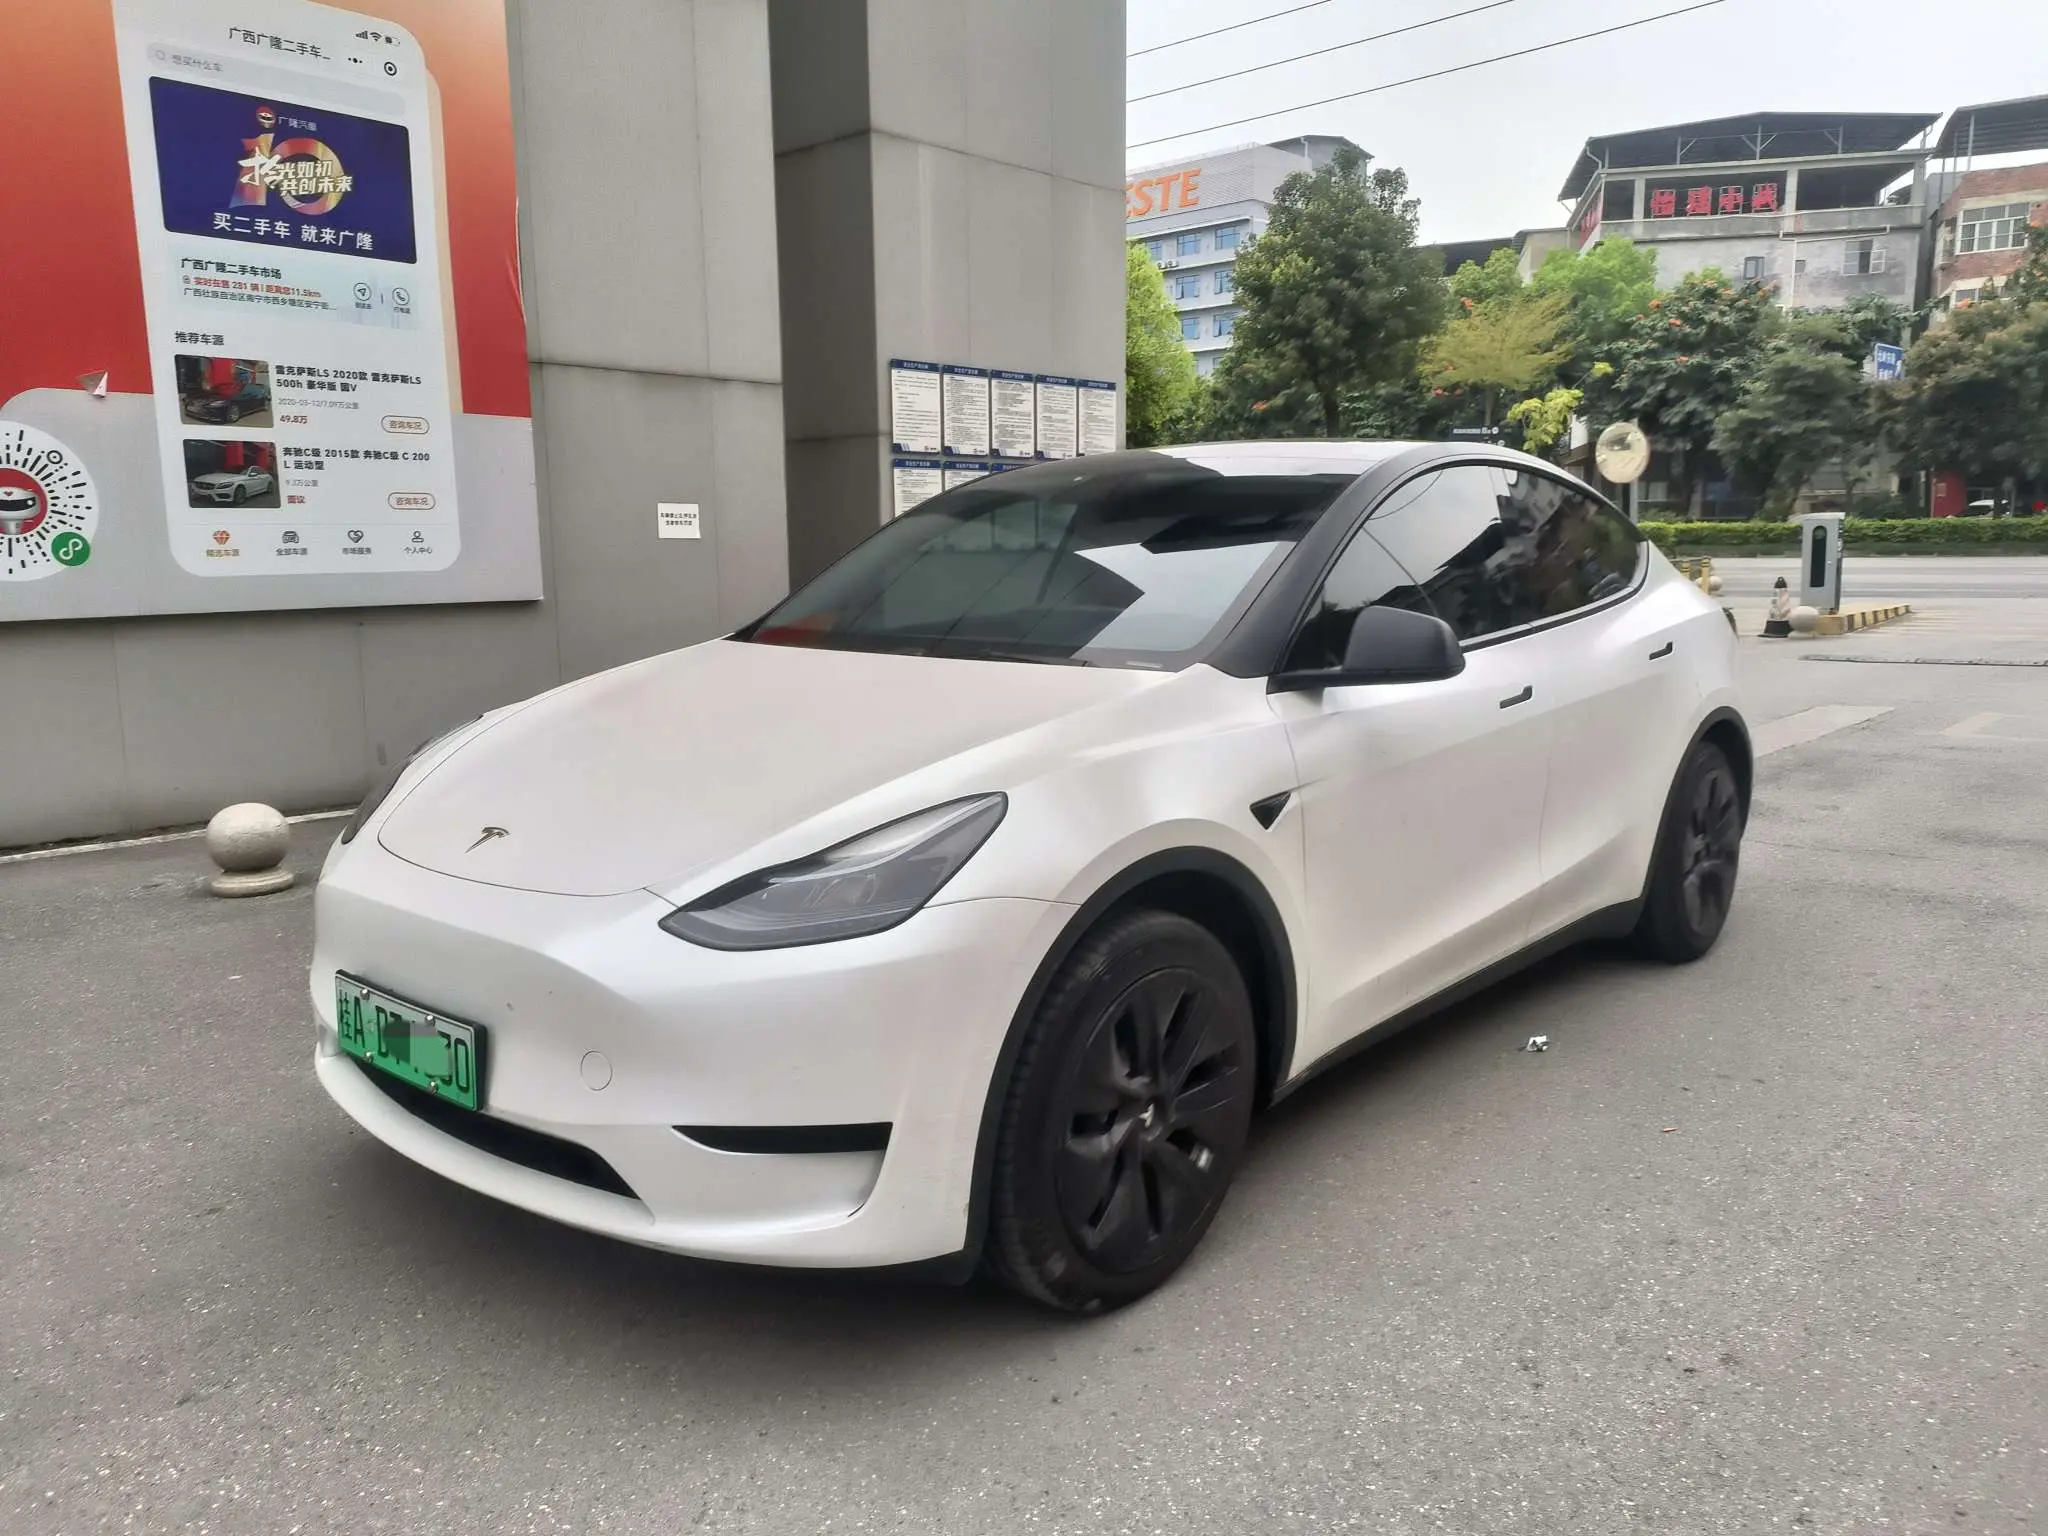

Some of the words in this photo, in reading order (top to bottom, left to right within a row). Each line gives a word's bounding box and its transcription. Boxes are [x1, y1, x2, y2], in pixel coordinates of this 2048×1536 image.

[280, 176, 352, 196] 共创未来
[213, 212, 291, 239] 买二手车
[301, 224, 374, 251] 就来广隆
[181, 258, 282, 279] 广西广隆二手车市场
[174, 330, 224, 346] 推荐车源
[275, 365, 329, 378] 雷克萨斯LS
[333, 370, 368, 381] 2020款
[371, 372, 421, 385] 雷克萨斯LS
[276, 379, 303, 389] 500h
[306, 380, 337, 391] 豪华版
[280, 414, 308, 425] 49.8万
[282, 447, 322, 458] 奔驰C级
[324, 449, 360, 459] 2015款
[363, 450, 399, 461] 奔驰C级
[402, 452, 409, 461] C
[412, 452, 430, 461] 200
[283, 460, 291, 469] L
[294, 460, 325, 471] 运动型
